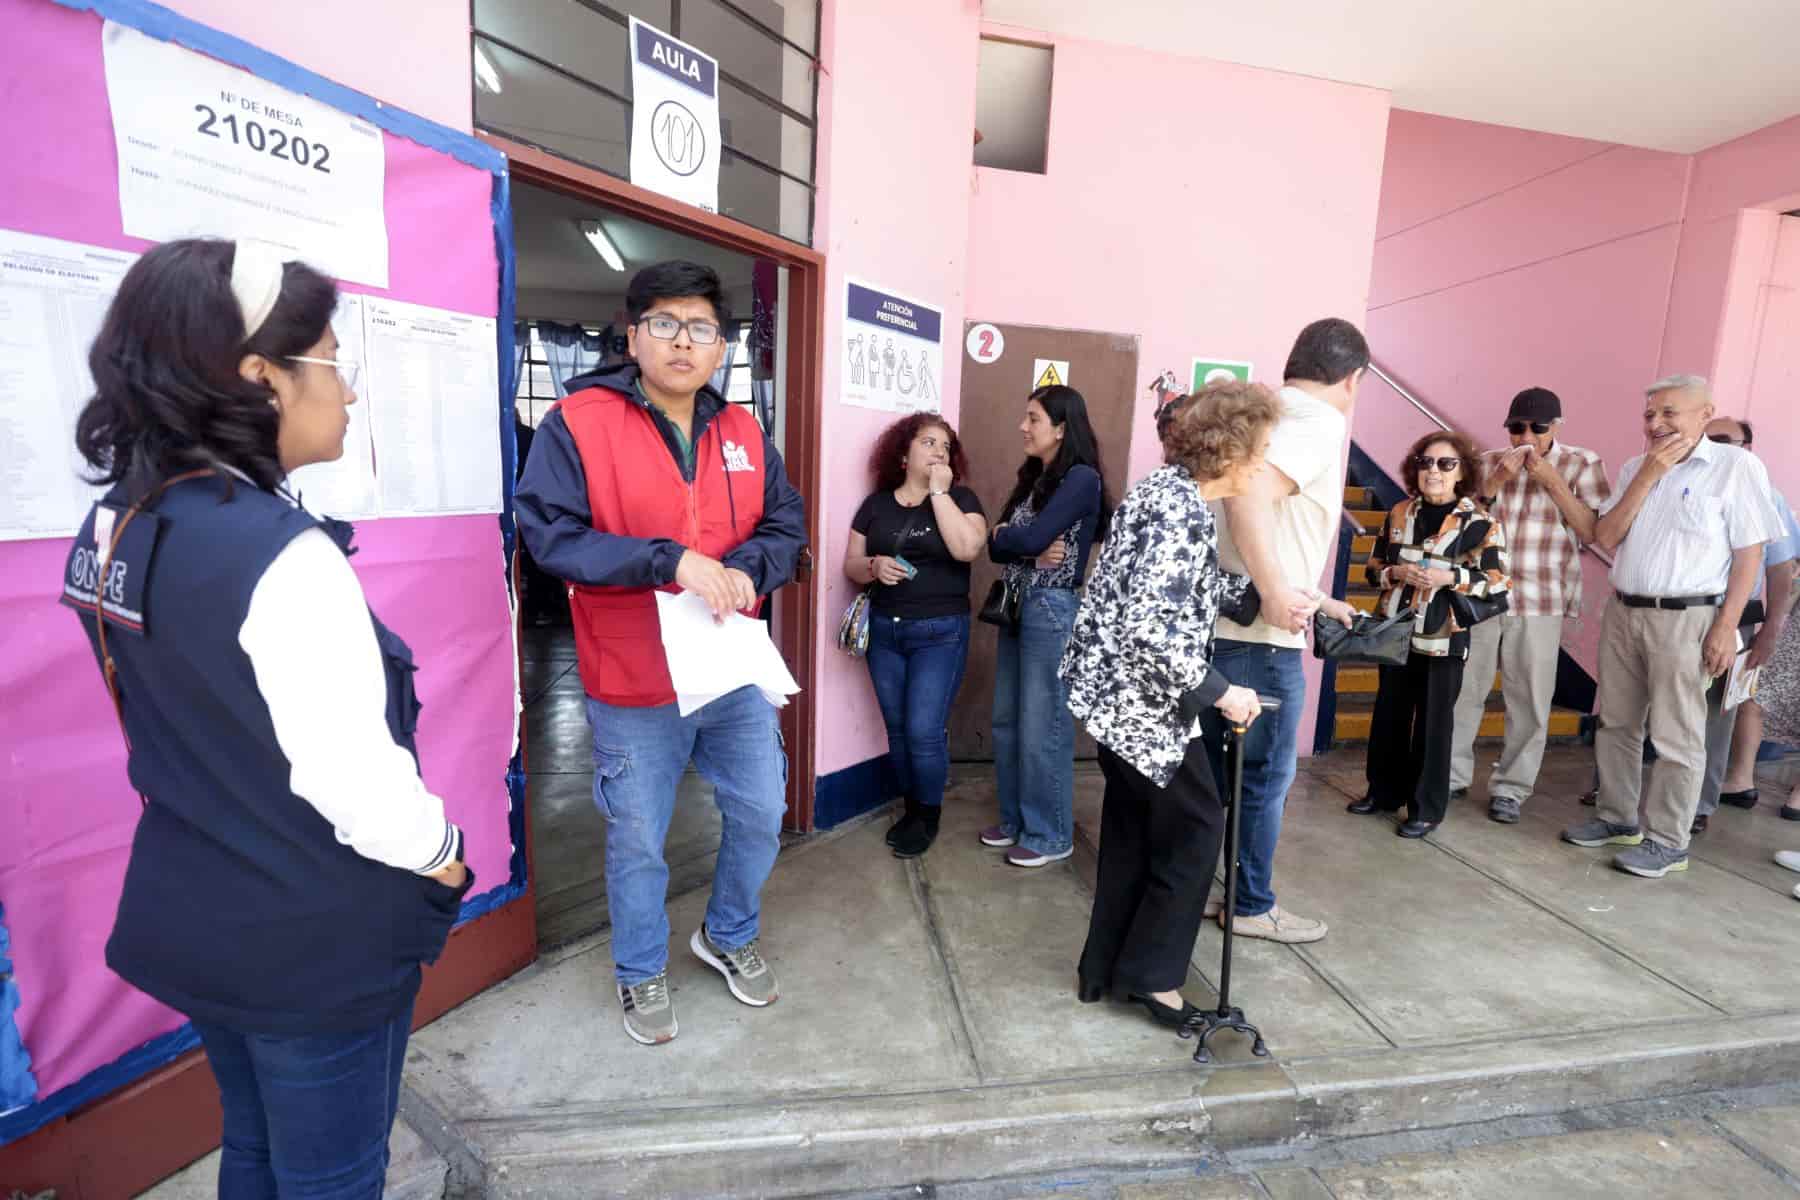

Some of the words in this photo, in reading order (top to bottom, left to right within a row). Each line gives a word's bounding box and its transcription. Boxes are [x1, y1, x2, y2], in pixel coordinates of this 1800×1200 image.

[651, 41, 701, 82] AULA
[241, 98, 261, 114] DE
[264, 105, 303, 128] MESA
[195, 103, 331, 174] 210202
[660, 112, 694, 169] 101
[876, 310, 918, 331] PREFERENCIAL
[978, 330, 994, 358] 2
